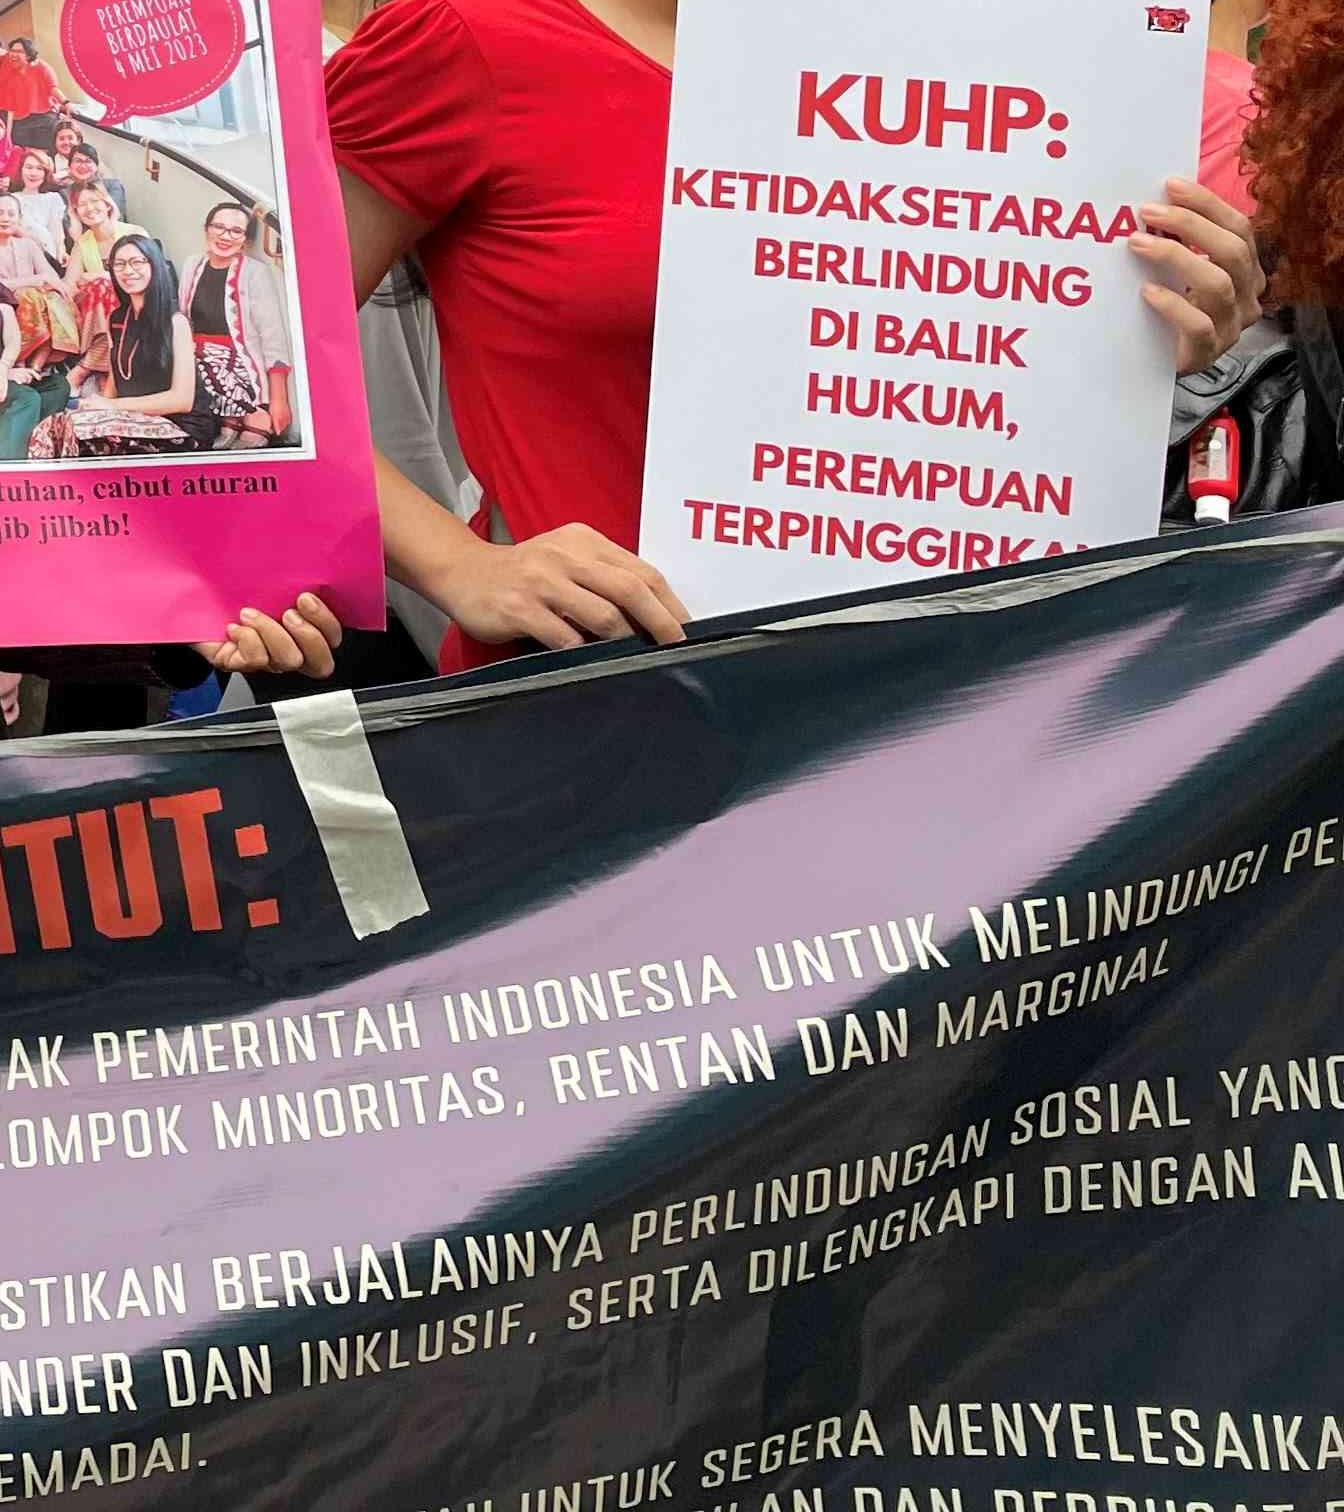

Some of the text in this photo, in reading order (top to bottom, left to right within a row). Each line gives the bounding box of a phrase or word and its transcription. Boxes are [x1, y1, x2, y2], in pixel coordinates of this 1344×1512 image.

[105, 7, 198, 56] BERDAULAT
[113, 32, 209, 80] 4 MEI 2023
[795, 69, 1070, 161] KUHP:
[671, 167, 1150, 245] KETIDAKSETARAA
[753, 236, 1093, 308] BERLINDUNG
[808, 307, 1029, 369] DI BALIK
[805, 372, 1019, 441] HUKUM,
[92, 472, 173, 502] cabut
[180, 470, 279, 496] aturan
[752, 442, 1073, 517] PEREMPUAN
[37, 511, 131, 544] jilbab!
[94, 1000, 422, 1084] PEMERINTAH
[442, 954, 738, 1044] INDONESIA
[755, 911, 951, 993] UNTUK
[968, 843, 1270, 964] MELINDUNGI
[1282, 816, 1344, 875] PE
[212, 1064, 527, 1153] MINORITAS,
[548, 1023, 776, 1106] RENTAN
[798, 1006, 912, 1077] DAN
[934, 938, 1171, 1049] MARGINAL
[211, 1220, 605, 1313] BERJALANNYA
[629, 1117, 993, 1255] PERLINDUNGAN
[1010, 1075, 1192, 1148] SOSIAL
[163, 1342, 274, 1410] DAN
[298, 1301, 539, 1389] INKLUSIF,
[565, 1259, 724, 1332] SERTA
[746, 1172, 1016, 1296] DILENGKAPI
[1043, 1144, 1256, 1217] DENGAN
[699, 1408, 884, 1491] SEGERA
